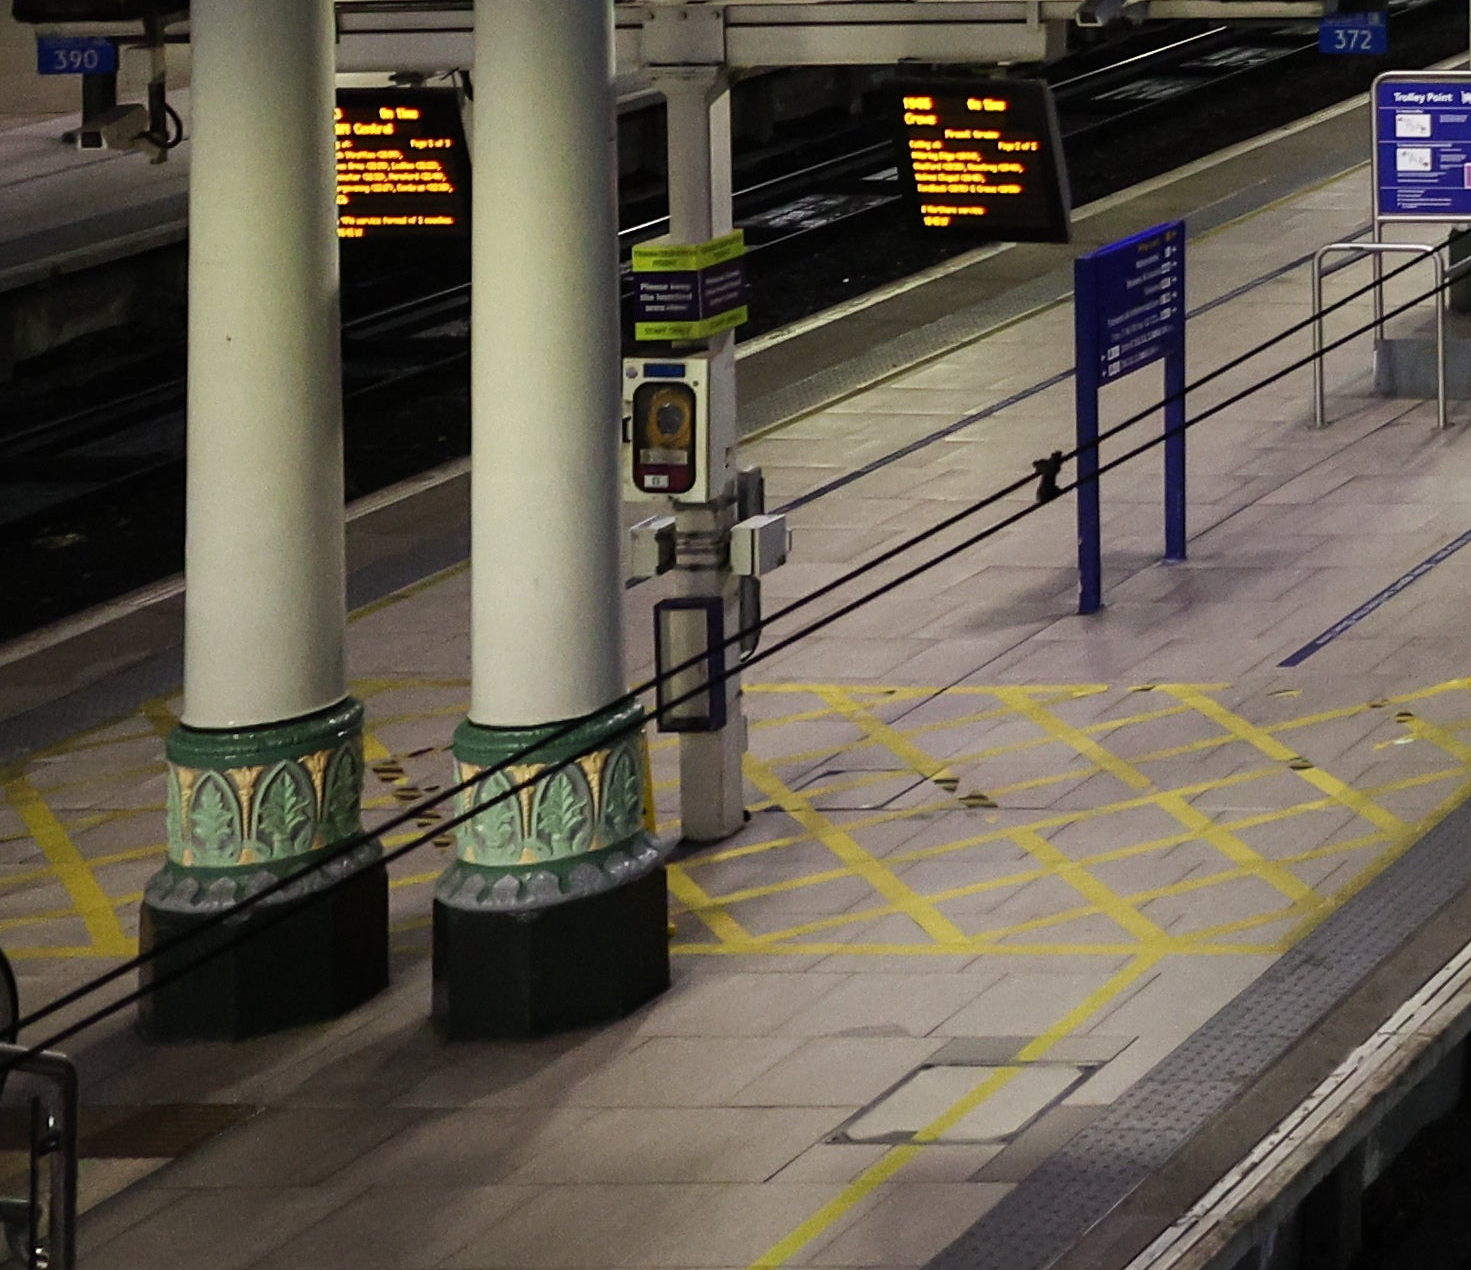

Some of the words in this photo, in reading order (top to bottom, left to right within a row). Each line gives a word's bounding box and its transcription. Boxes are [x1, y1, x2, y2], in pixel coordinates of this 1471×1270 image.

[1334, 28, 1372, 50] 372
[53, 49, 99, 70] 390
[1393, 92, 1426, 104] Trolley
[1426, 92, 1454, 103] Point
